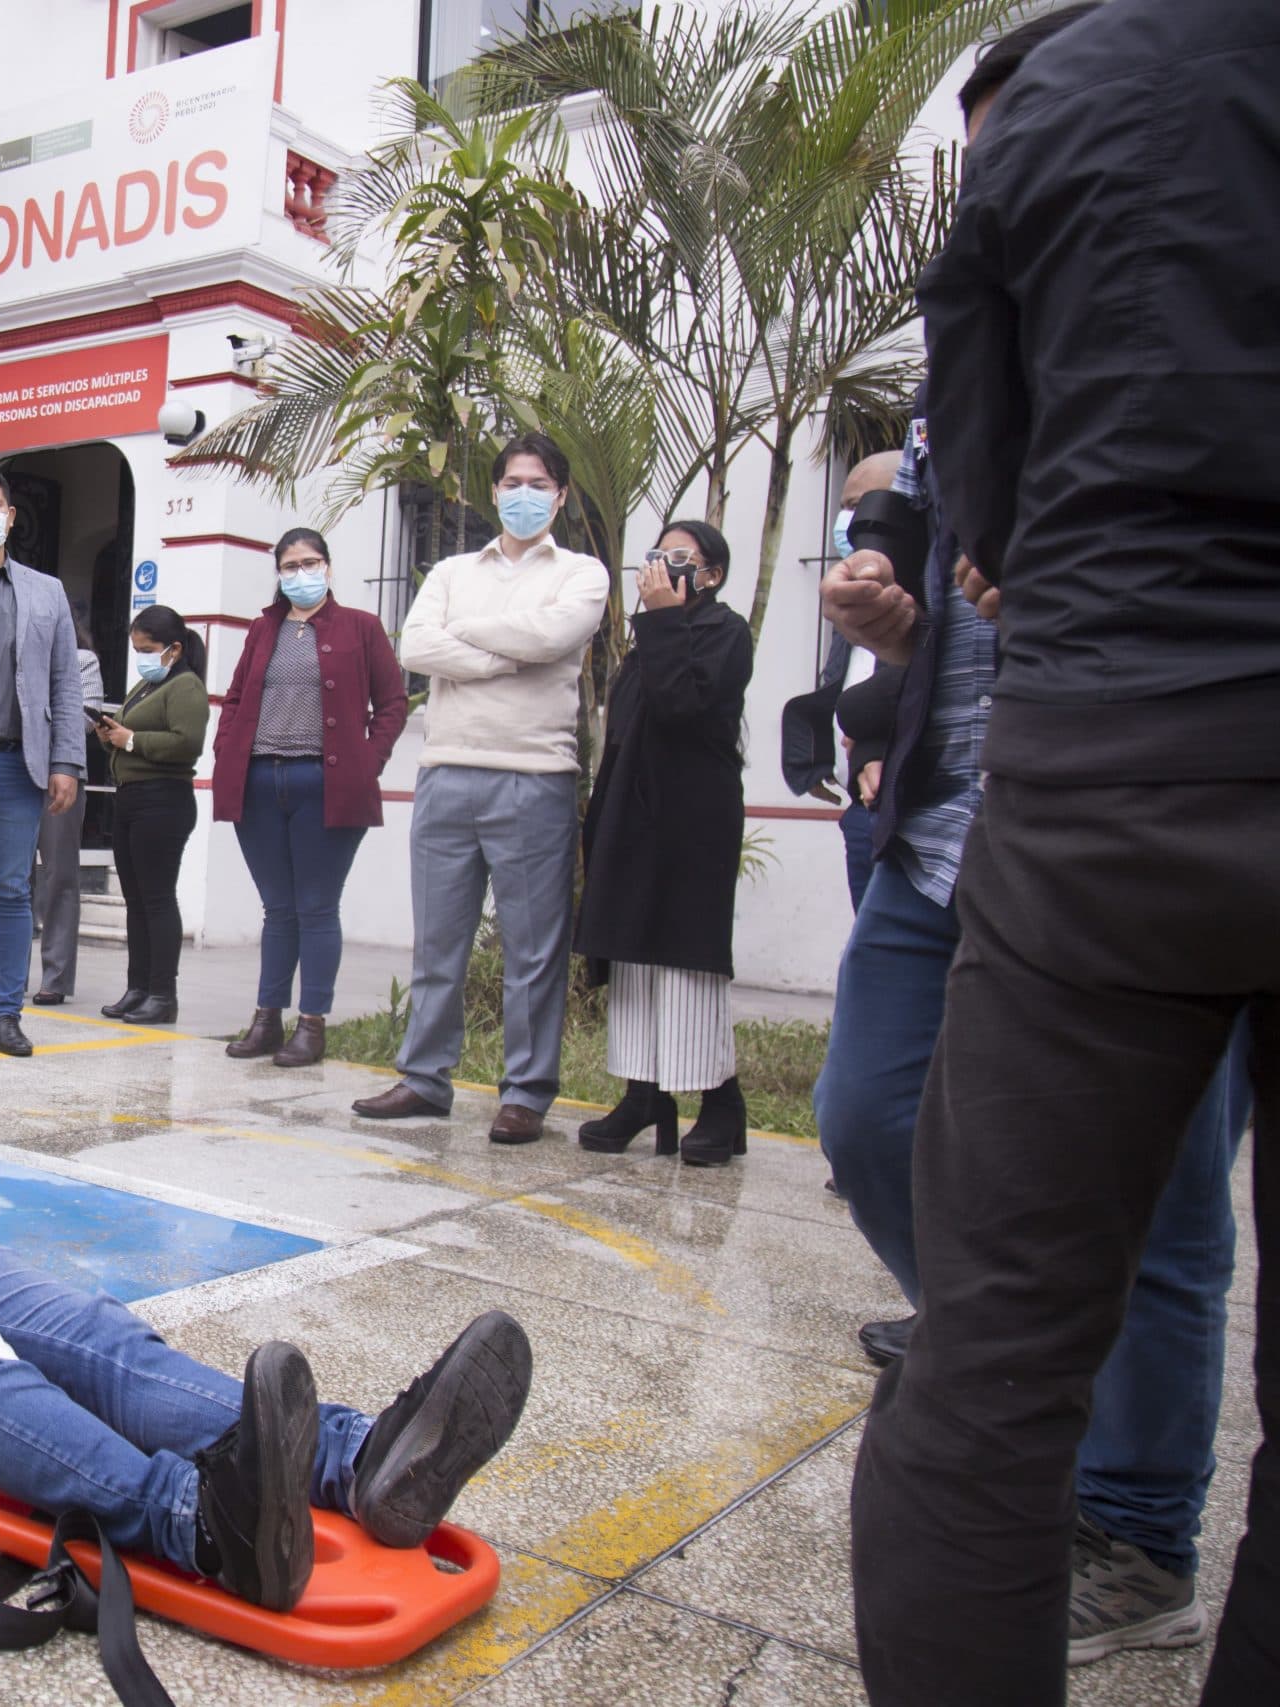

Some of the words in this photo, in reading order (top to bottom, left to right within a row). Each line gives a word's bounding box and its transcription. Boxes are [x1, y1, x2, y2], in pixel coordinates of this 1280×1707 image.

[21, 387, 35, 401] DE
[36, 379, 89, 398] SERVICIOS
[91, 368, 149, 390] MÚLTIPLES
[40, 402, 62, 417] CON
[64, 390, 141, 413] DISCAPACIDAD
